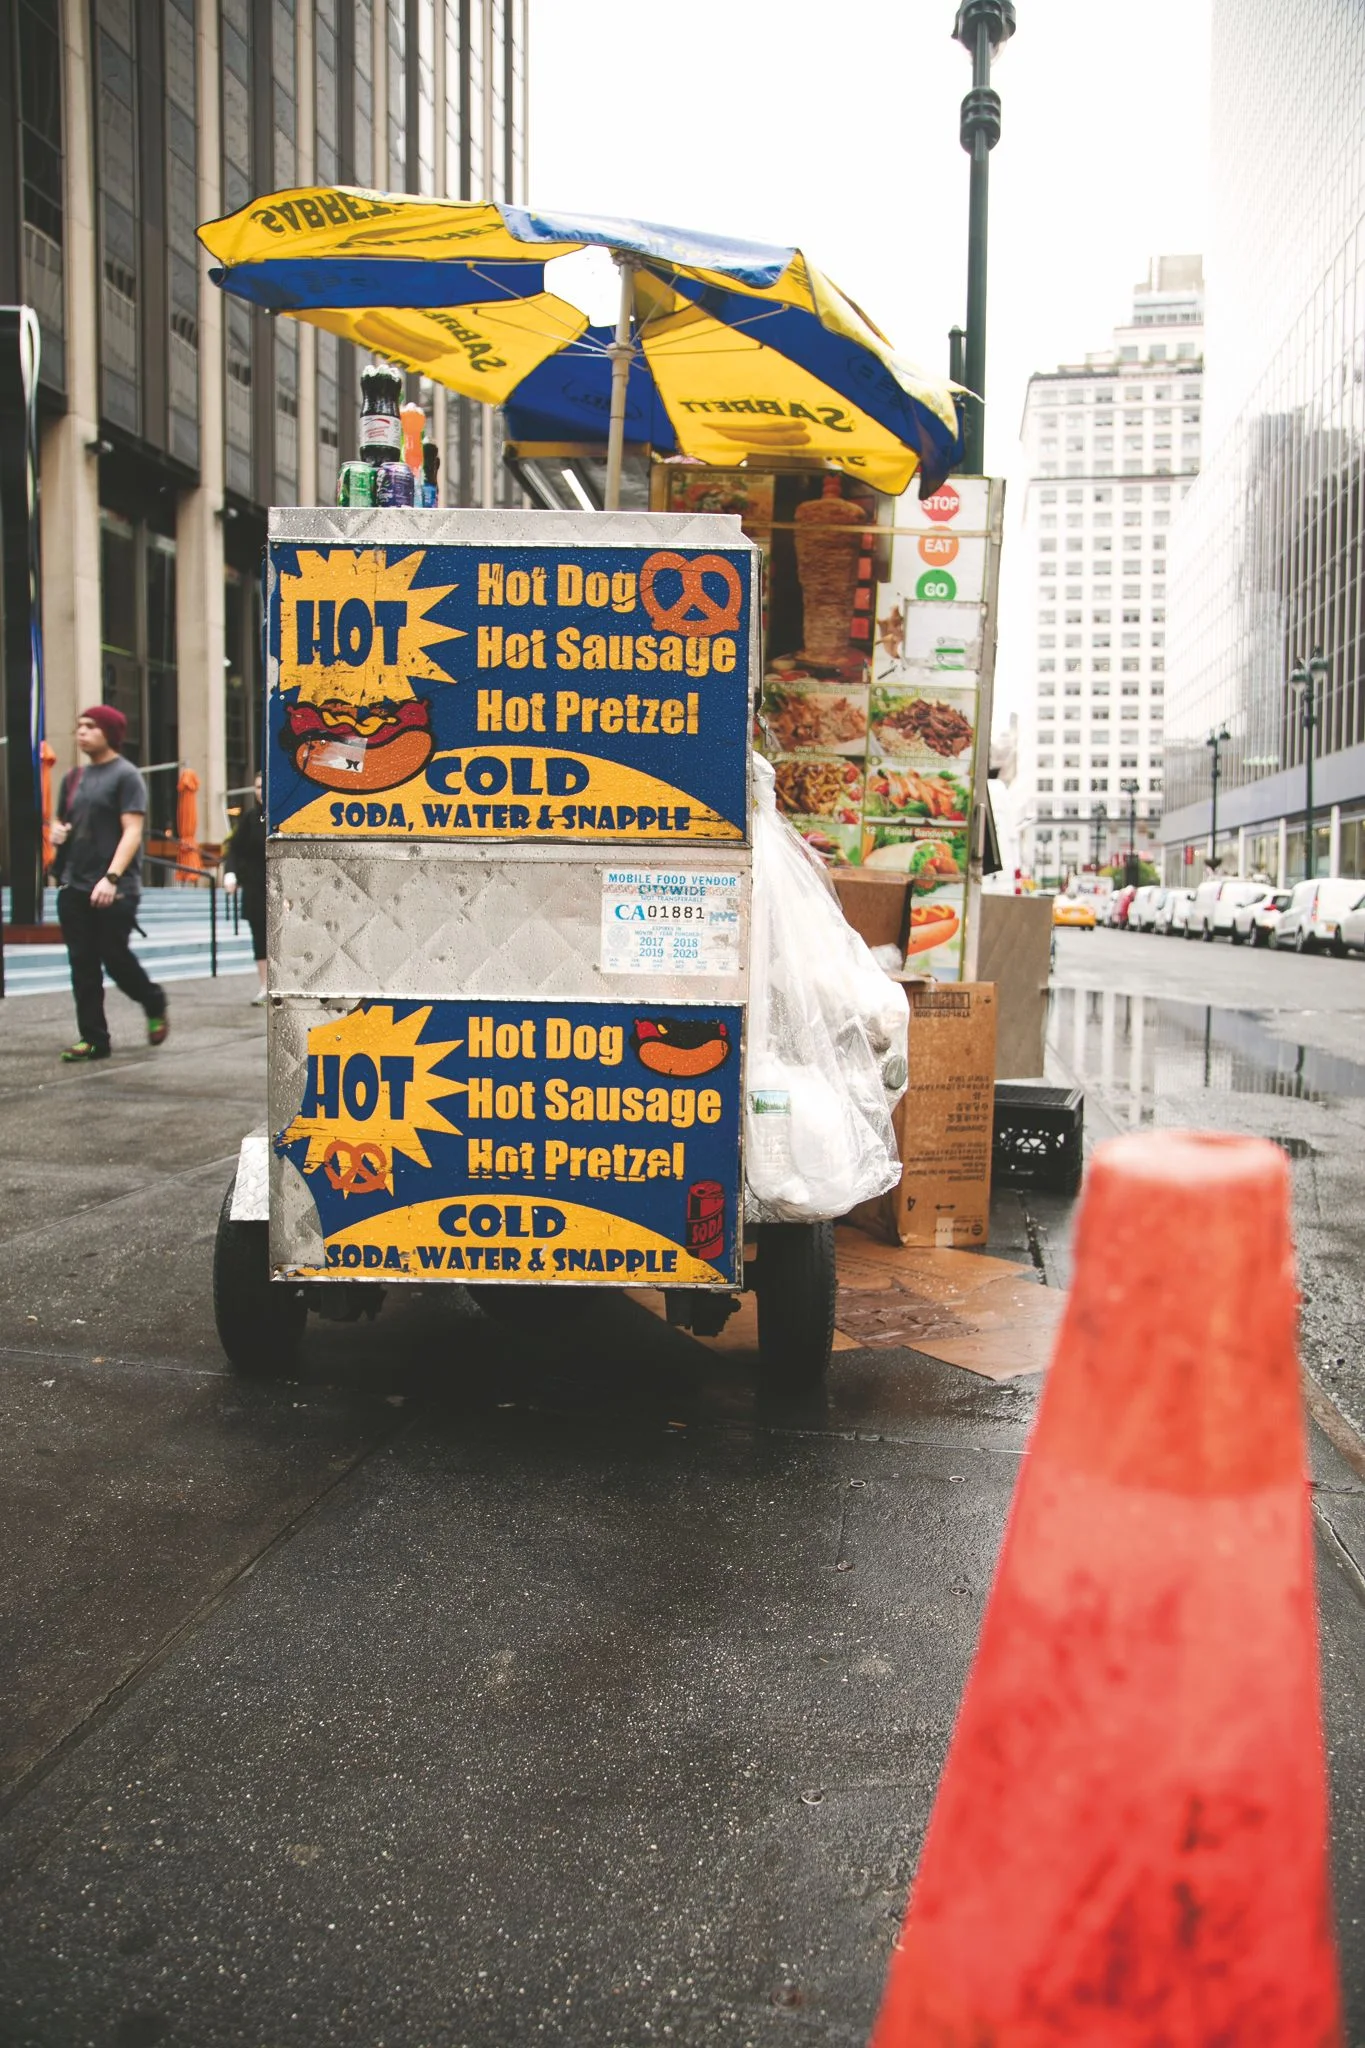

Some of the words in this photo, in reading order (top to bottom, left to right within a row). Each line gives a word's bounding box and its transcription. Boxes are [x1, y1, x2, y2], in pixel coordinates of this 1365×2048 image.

[922, 496, 959, 511] STOP
[924, 539, 953, 553] EAT
[477, 563, 547, 607] Hot
[557, 565, 637, 613] Dog
[924, 583, 949, 598] GO
[296, 597, 407, 667] HOT
[477, 626, 547, 670] Hot
[556, 627, 737, 677] Sausage
[477, 690, 547, 733] Hot
[556, 690, 699, 735] Pretzel
[425, 756, 590, 796] COLD
[330, 803, 414, 832] SODA,
[421, 803, 528, 831] WATER
[536, 805, 555, 831] &
[564, 805, 691, 832] SNAPPLE
[865, 827, 876, 836] 12
[884, 827, 913, 836] Falafel
[914, 829, 955, 838] Sandwich
[608, 873, 651, 884] MOBILE
[657, 875, 686, 885] FOOD
[691, 876, 737, 886] VENDOR
[638, 884, 706, 897] CITYWIDE
[639, 937, 664, 946] 2017
[673, 938, 698, 948] 2018
[639, 948, 664, 957] 2019
[672, 949, 698, 959] 2020
[468, 1016, 536, 1060] Hot
[546, 1018, 623, 1066] Dog
[300, 1054, 414, 1122] HOT
[468, 1078, 536, 1121] Hot
[545, 1078, 722, 1128] Sausage
[468, 1139, 536, 1179] Hot
[545, 1140, 684, 1182] Pretzel
[438, 1204, 566, 1238] COLD
[692, 1213, 723, 1244] SODA
[417, 1246, 521, 1272] WATER
[528, 1250, 546, 1272] &
[554, 1248, 678, 1273] SNAPPLE
